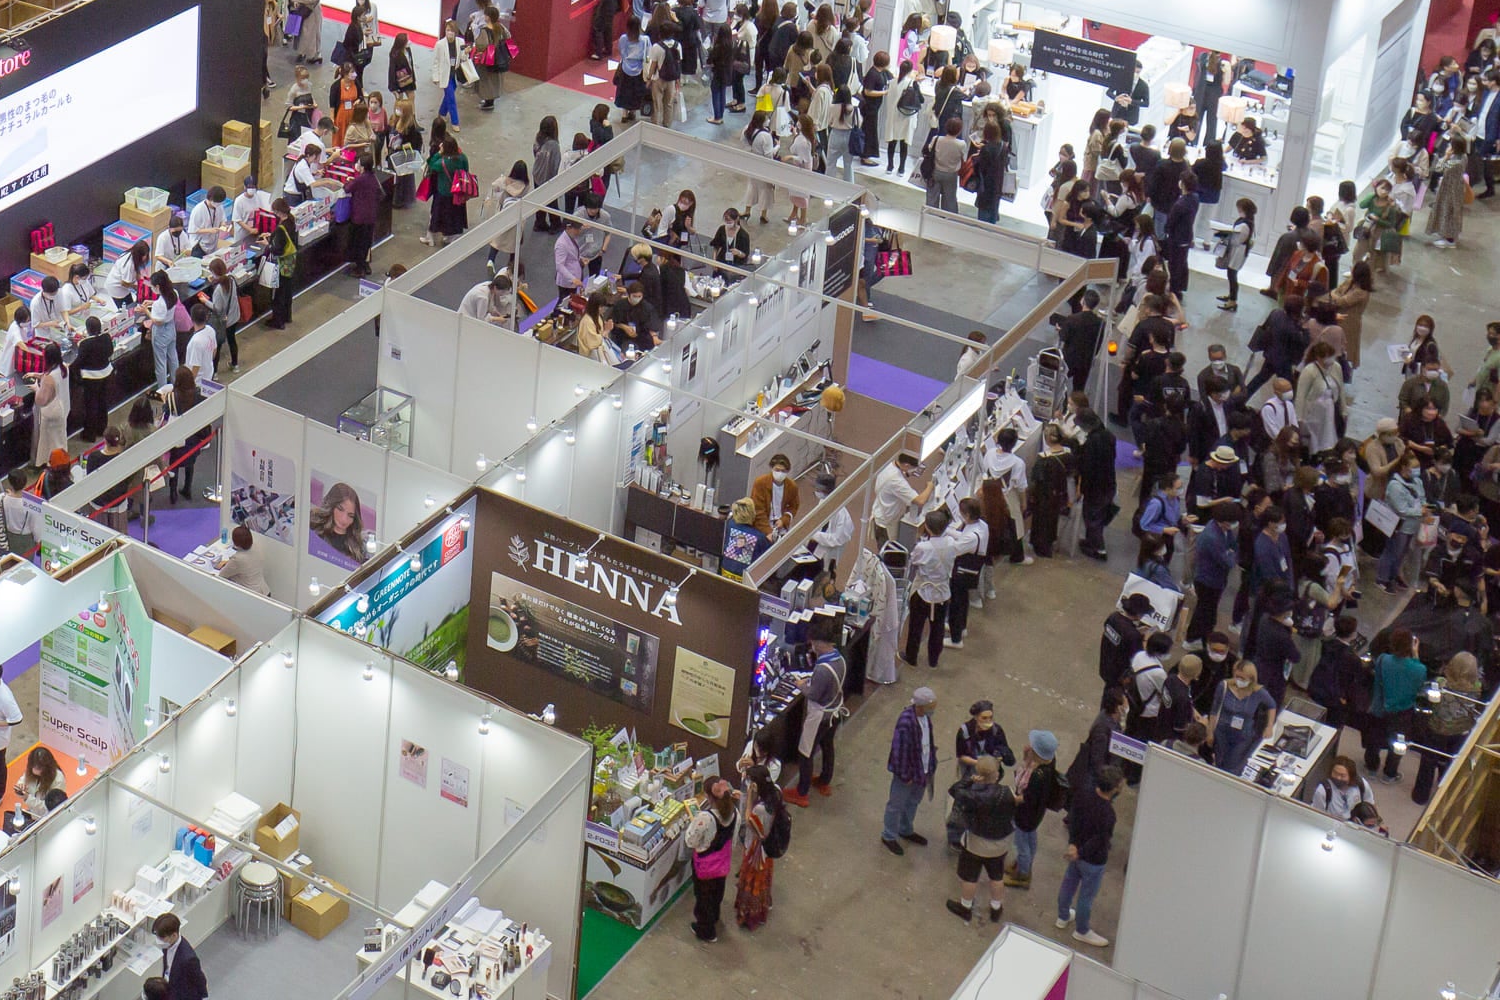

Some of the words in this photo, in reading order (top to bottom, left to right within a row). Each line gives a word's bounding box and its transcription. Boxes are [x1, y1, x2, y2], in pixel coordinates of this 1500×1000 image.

[0, 93, 73, 137] ナチュラルカールも
[11, 165, 48, 193] サイズ使用
[44, 514, 78, 537] Super
[81, 529, 105, 547] Sca
[373, 568, 411, 603] GREENNOTE
[533, 538, 683, 627] HENNA
[42, 710, 74, 733] Super
[77, 728, 108, 751] Scalp
[587, 832, 616, 847] 2-F032
